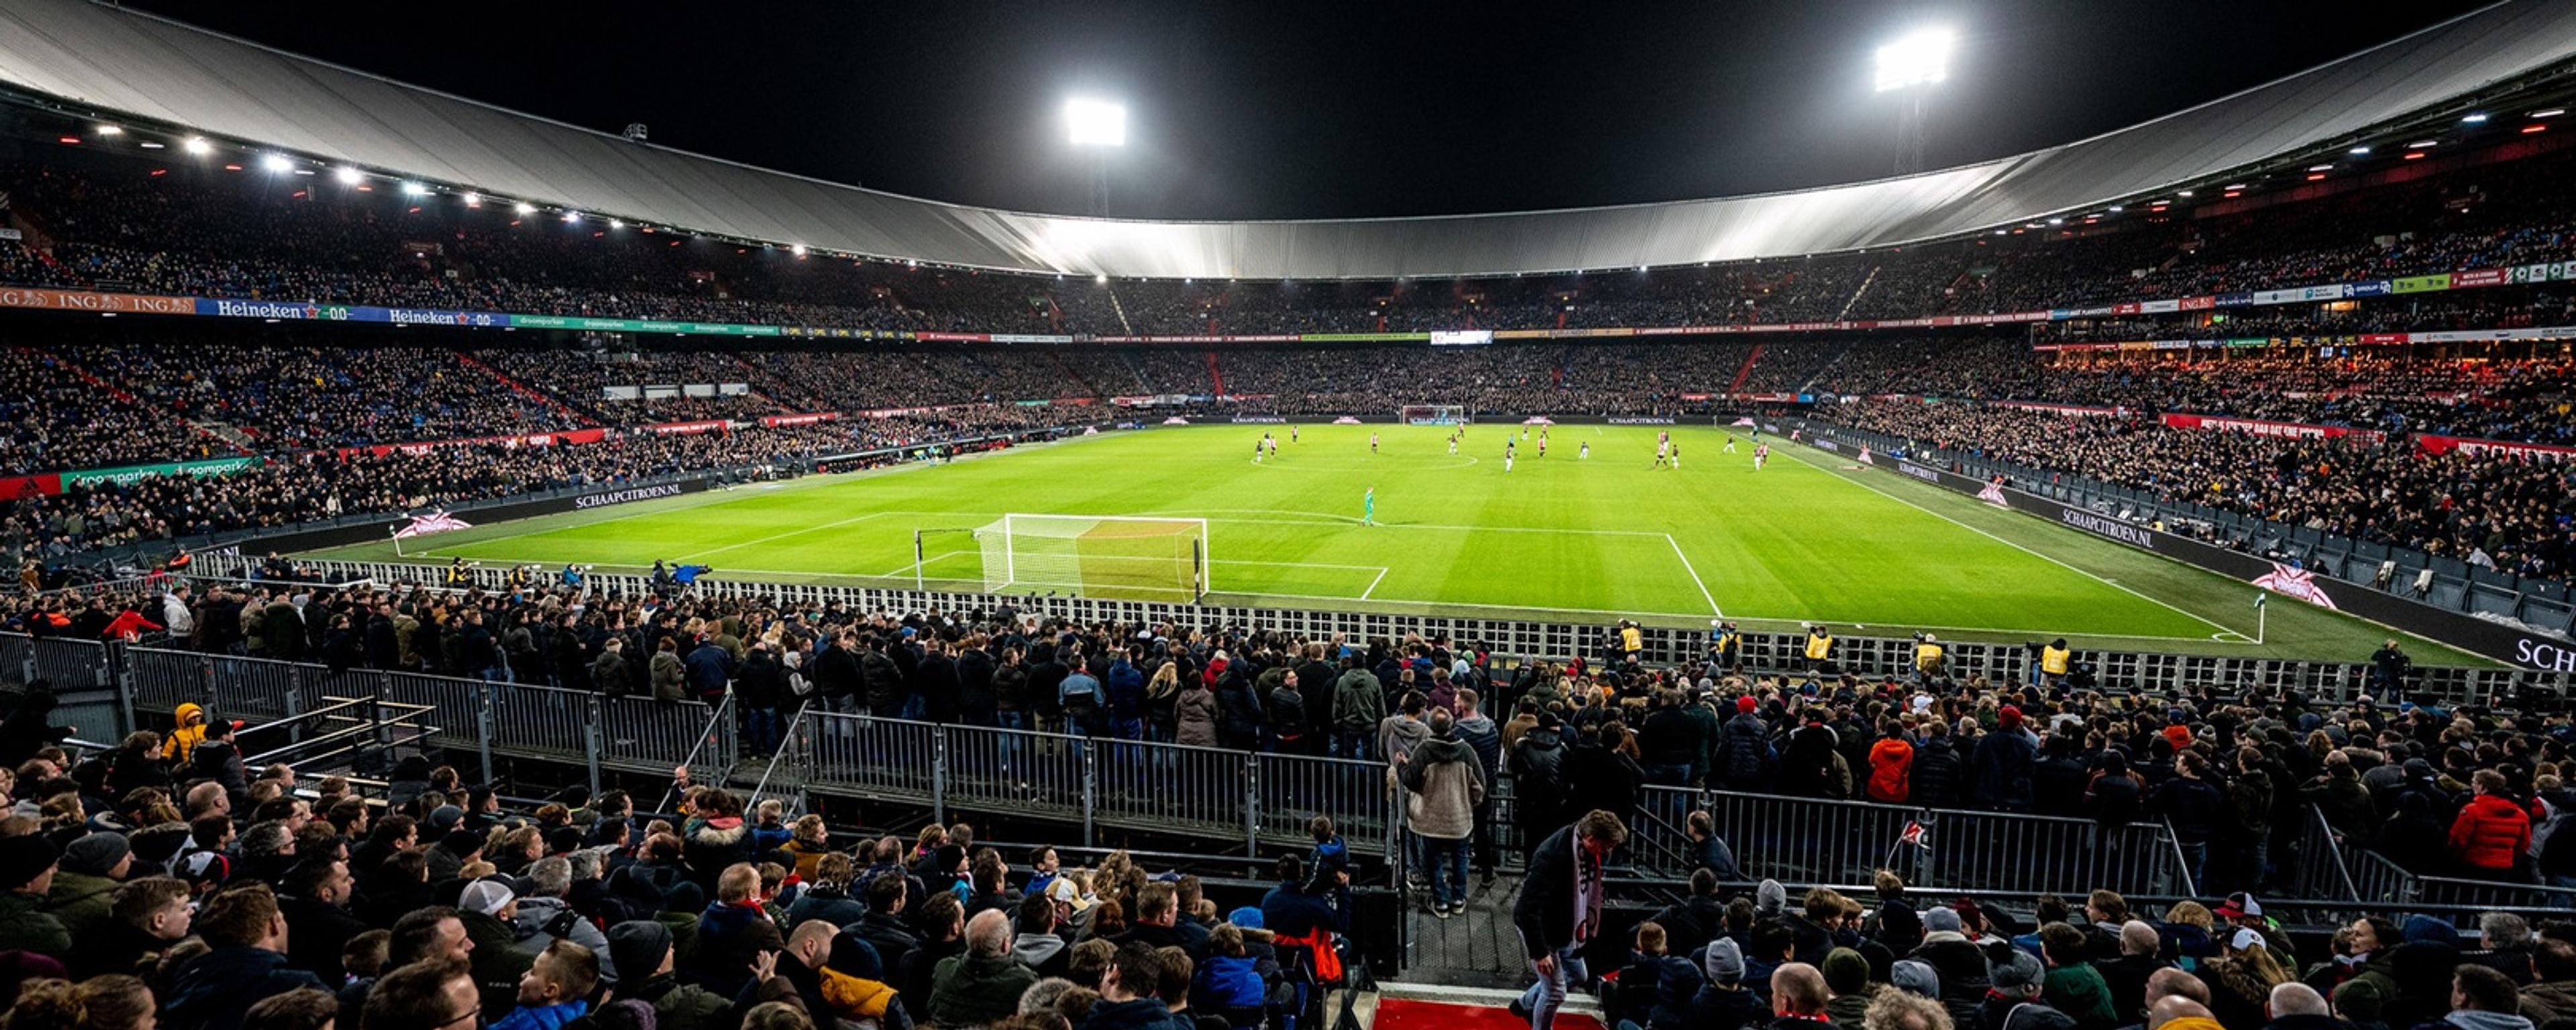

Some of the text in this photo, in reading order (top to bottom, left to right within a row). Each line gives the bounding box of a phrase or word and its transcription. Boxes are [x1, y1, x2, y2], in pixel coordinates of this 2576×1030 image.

[59, 295, 97, 309] ING
[133, 299, 168, 312] ING
[218, 300, 301, 319] Heineken
[390, 310, 455, 325] Heineken
[576, 483, 682, 508] SCHAAPCITROEN.NL
[2063, 508, 2153, 548] SCHAAPCITROEN.NL
